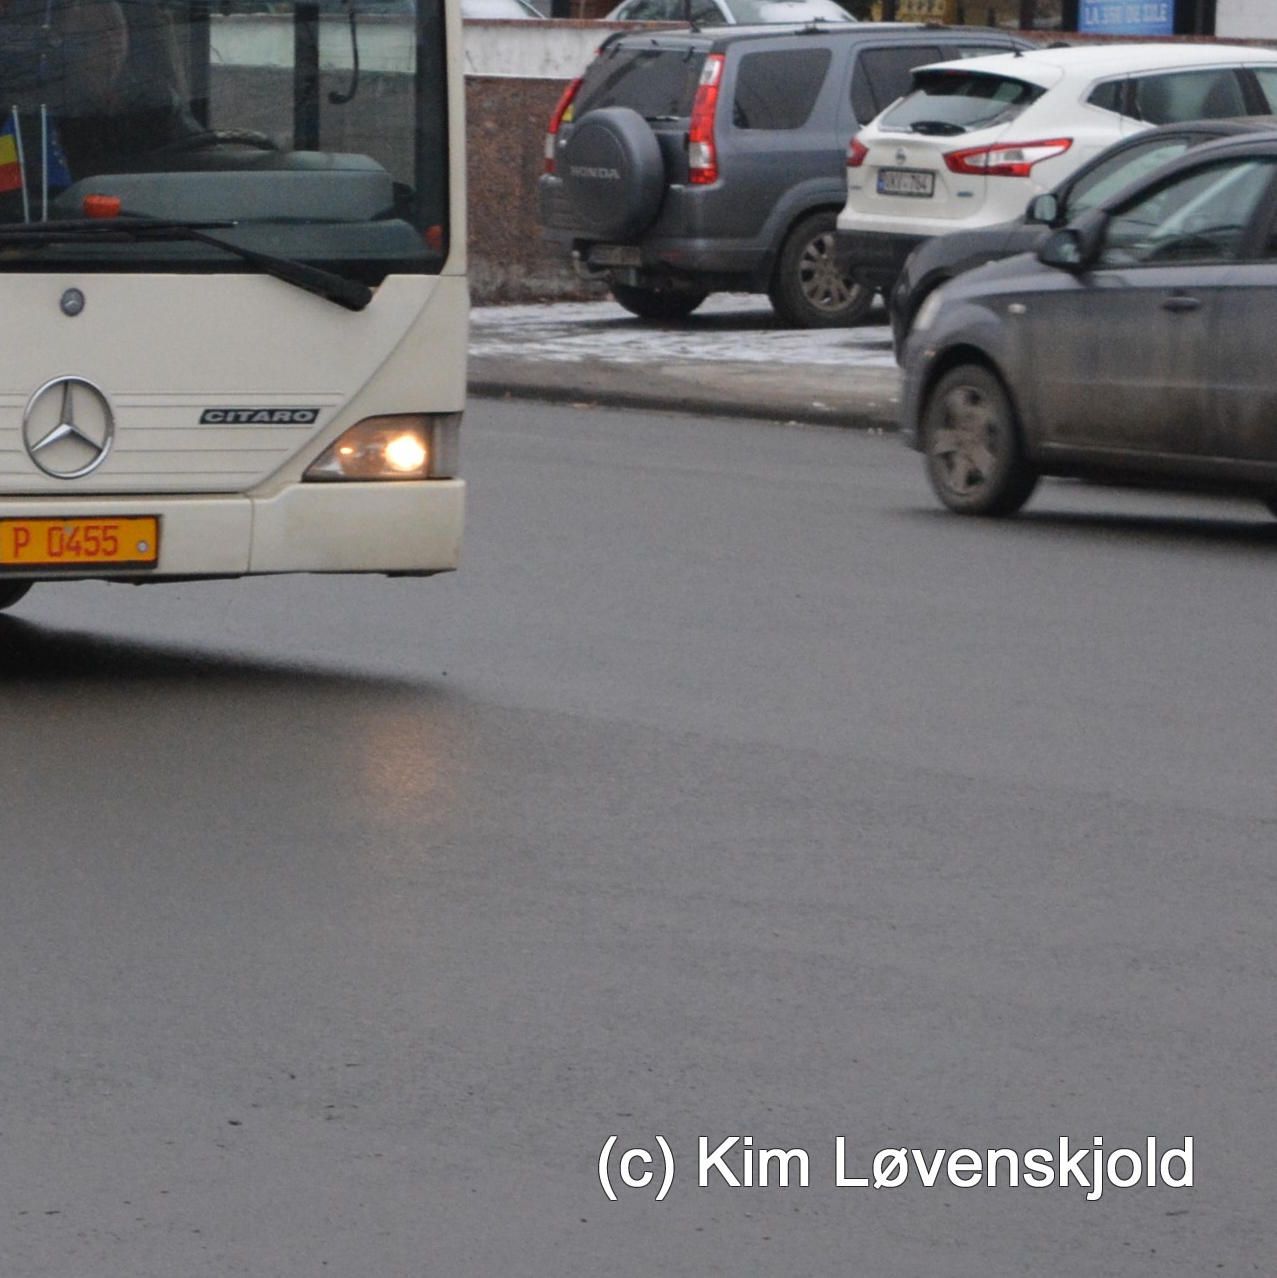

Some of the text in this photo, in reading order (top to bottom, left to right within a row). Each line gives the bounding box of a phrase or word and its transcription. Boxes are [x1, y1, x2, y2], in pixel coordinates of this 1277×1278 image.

[570, 165, 620, 179] HONDA
[204, 410, 315, 422] CITARO
[13, 524, 119, 558] P 0455
